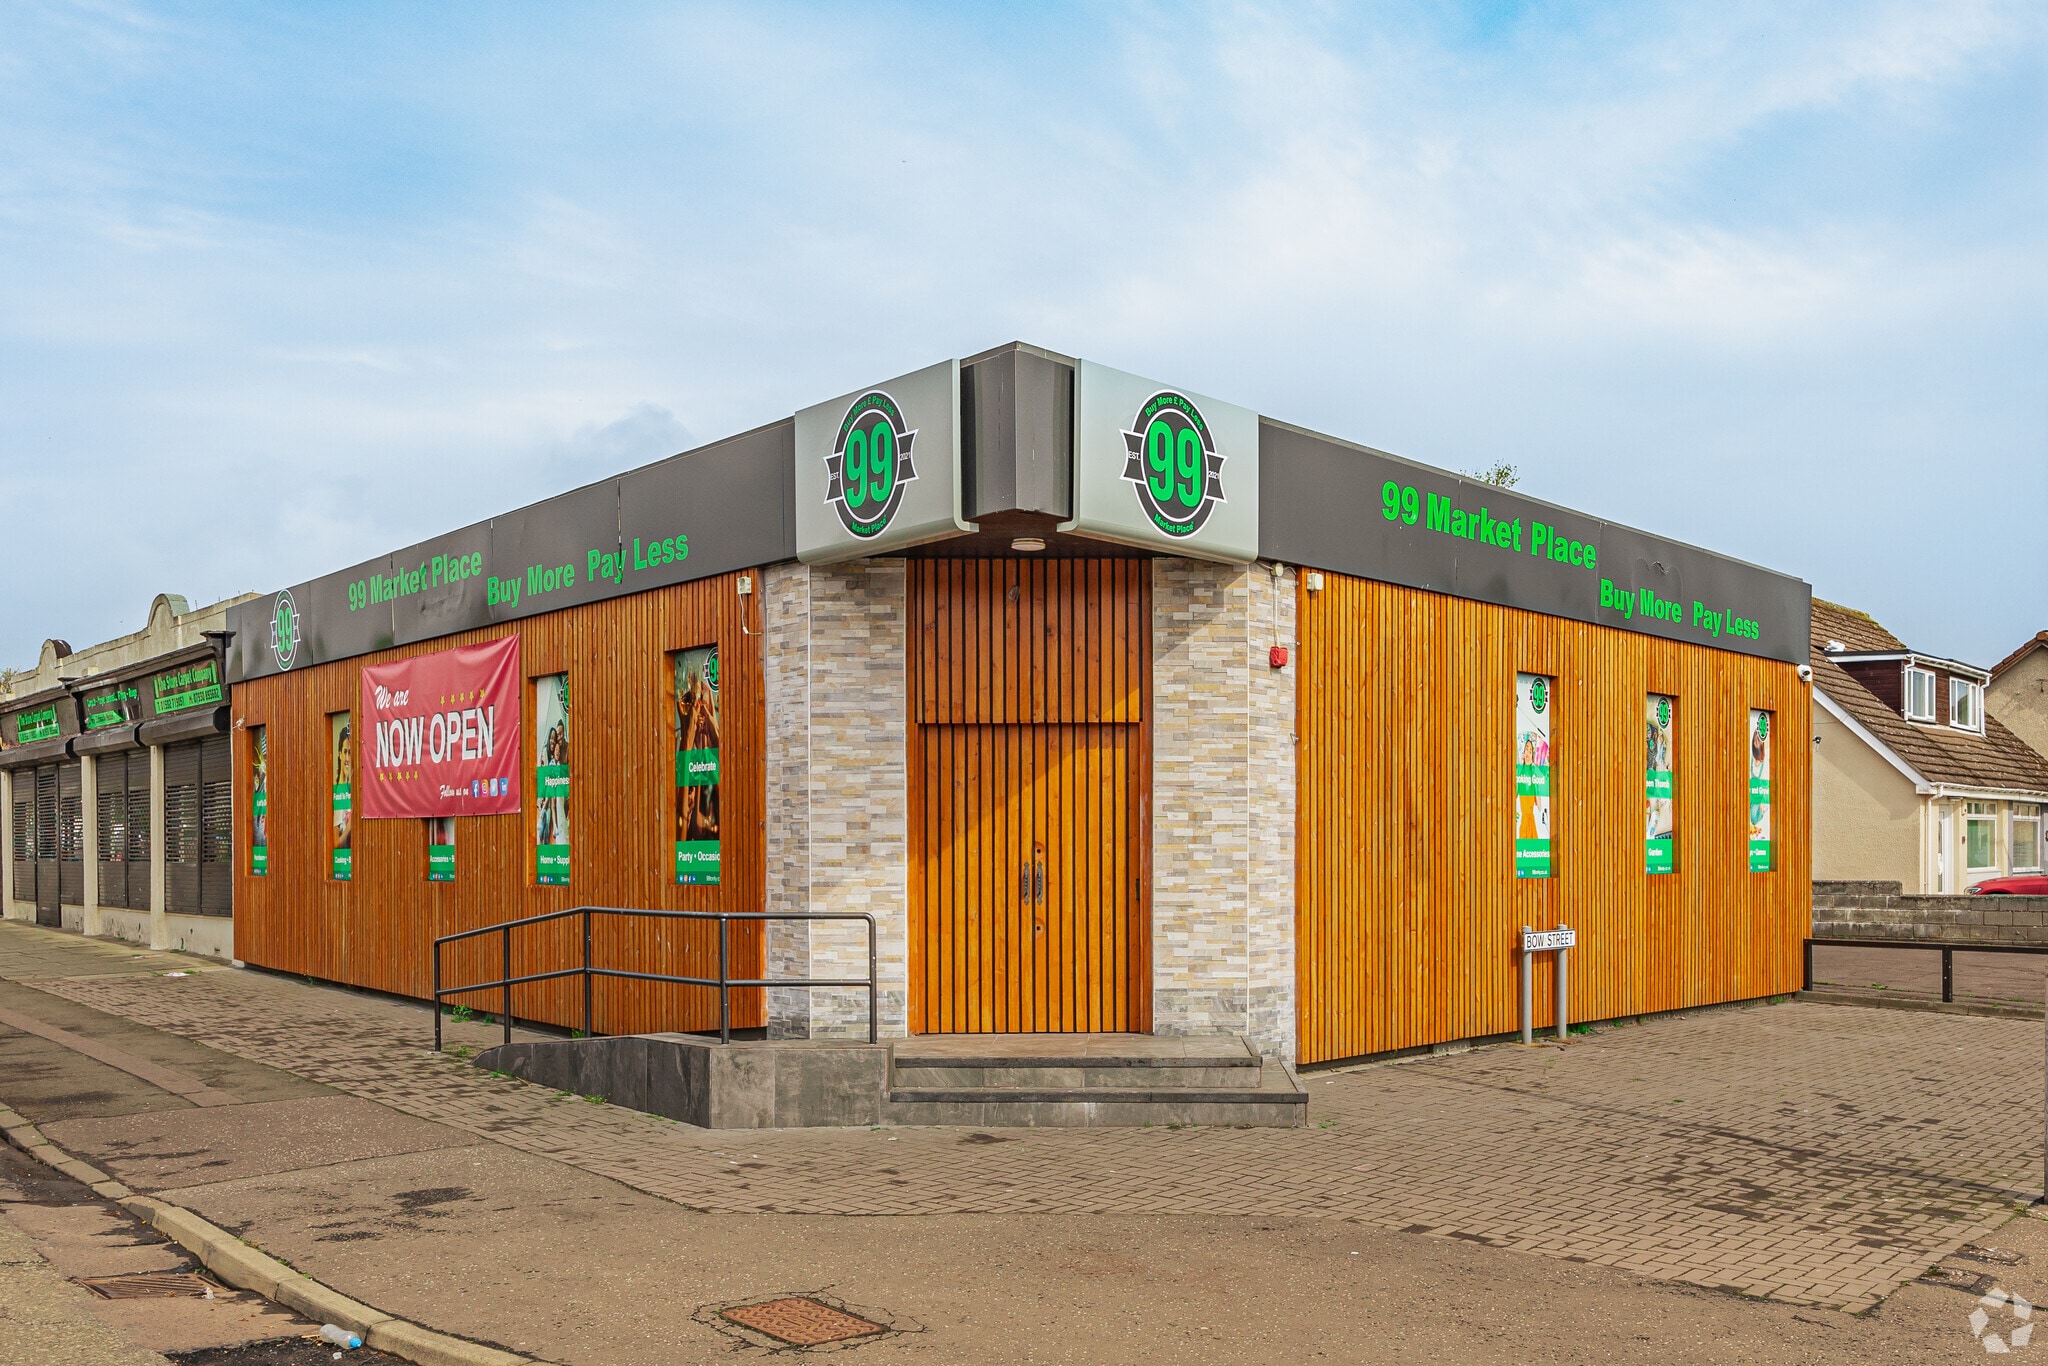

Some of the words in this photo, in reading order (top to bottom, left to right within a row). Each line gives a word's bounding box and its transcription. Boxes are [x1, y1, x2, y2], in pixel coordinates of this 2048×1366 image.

[872, 395, 883, 407] Pay
[1144, 402, 1157, 417] Buy
[1157, 396, 1173, 407] More
[1179, 398, 1191, 413] Pay
[1191, 409, 1204, 431] Less
[846, 421, 893, 508] 99
[1148, 420, 1202, 508] 99
[851, 521, 871, 534] Market
[1154, 513, 1176, 533] Market
[1381, 480, 1420, 525] 99
[1426, 492, 1522, 552] Market
[1531, 521, 1597, 570] Place
[587, 548, 625, 584] Pay
[634, 534, 689, 571] Less
[348, 581, 367, 612] 99
[370, 562, 427, 606] Market
[432, 551, 482, 585] Place
[488, 576, 522, 608] Buy
[527, 562, 575, 597] More
[1600, 578, 1635, 619] Buy
[1640, 588, 1682, 624] More
[277, 607, 294, 653] 99
[1693, 600, 1723, 638] Pay
[1726, 608, 1759, 640] Less
[158, 676, 167, 691] The
[178, 669, 193, 688] Carpet
[192, 667, 211, 684] Company
[374, 684, 391, 710] We
[393, 688, 409, 707] are
[1533, 684, 1545, 707] 99
[376, 714, 425, 768] NOW
[429, 704, 495, 764] OPEN
[688, 761, 717, 774] Celebrate
[1532, 775, 1545, 784] Good
[440, 784, 455, 800] Follow
[456, 788, 462, 796] us
[540, 856, 554, 864] Home
[678, 851, 693, 863] Party
[1526, 935, 1545, 949] BOW
[1547, 932, 1573, 947] STREET
